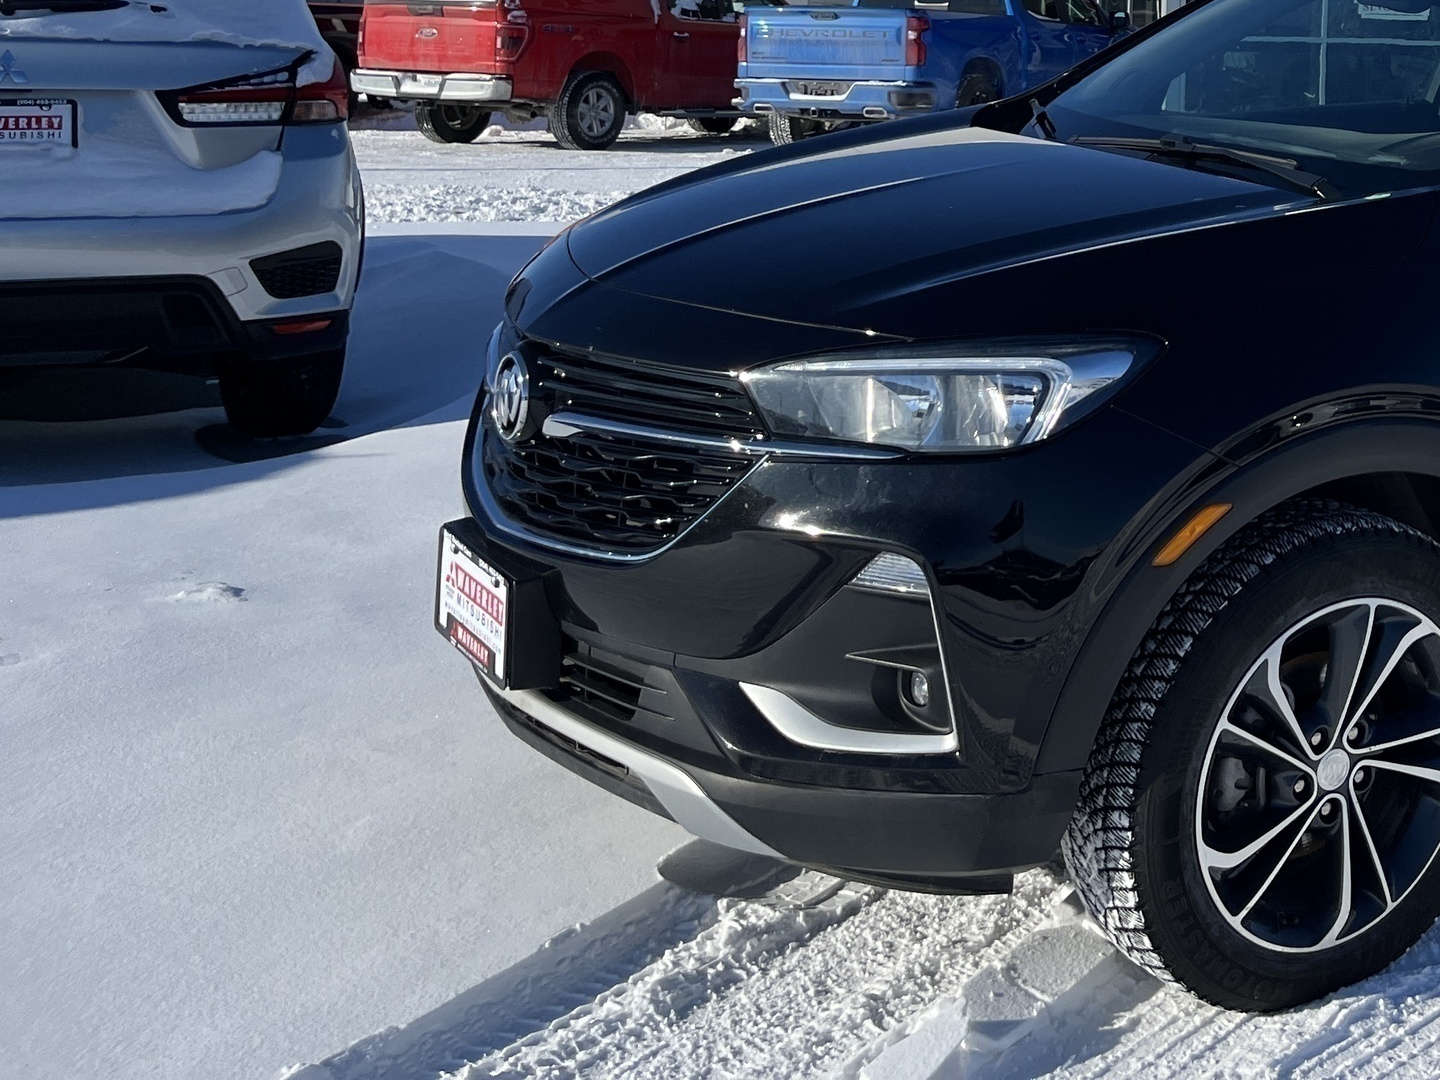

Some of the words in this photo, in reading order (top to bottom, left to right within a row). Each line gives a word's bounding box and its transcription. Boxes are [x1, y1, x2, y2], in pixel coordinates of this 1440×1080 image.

[456, 593, 503, 642] MITSUBISHI
[457, 567, 504, 626] WAVERLEY
[457, 625, 489, 663] WAVERLEY
